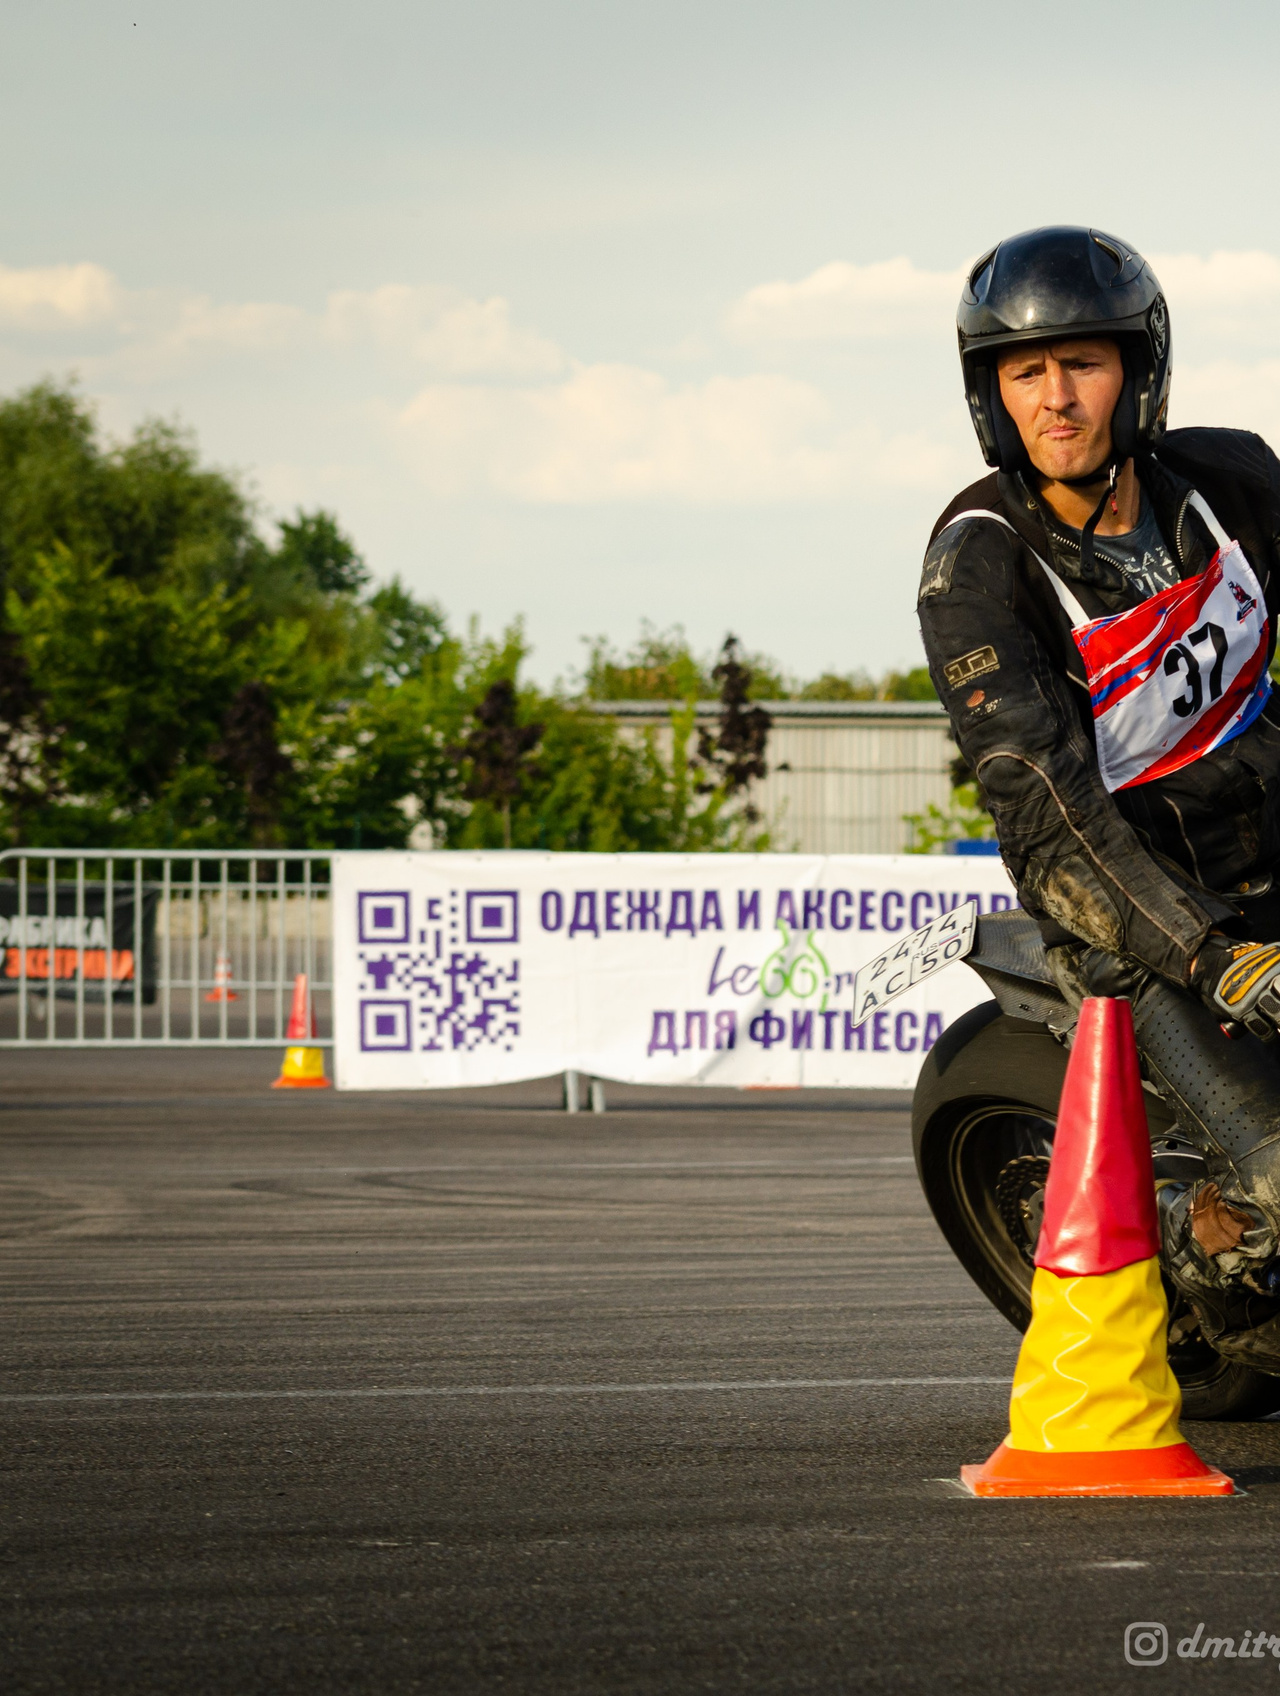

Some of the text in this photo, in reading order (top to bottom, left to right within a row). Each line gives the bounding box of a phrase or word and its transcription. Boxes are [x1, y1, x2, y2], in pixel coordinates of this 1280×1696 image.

[1163, 621, 1229, 718] 37
[540, 889, 724, 938] ОДЕЖДА
[737, 889, 761, 930] И
[920, 938, 962, 974] 50
[646, 1010, 738, 1057] ДЛЯ
